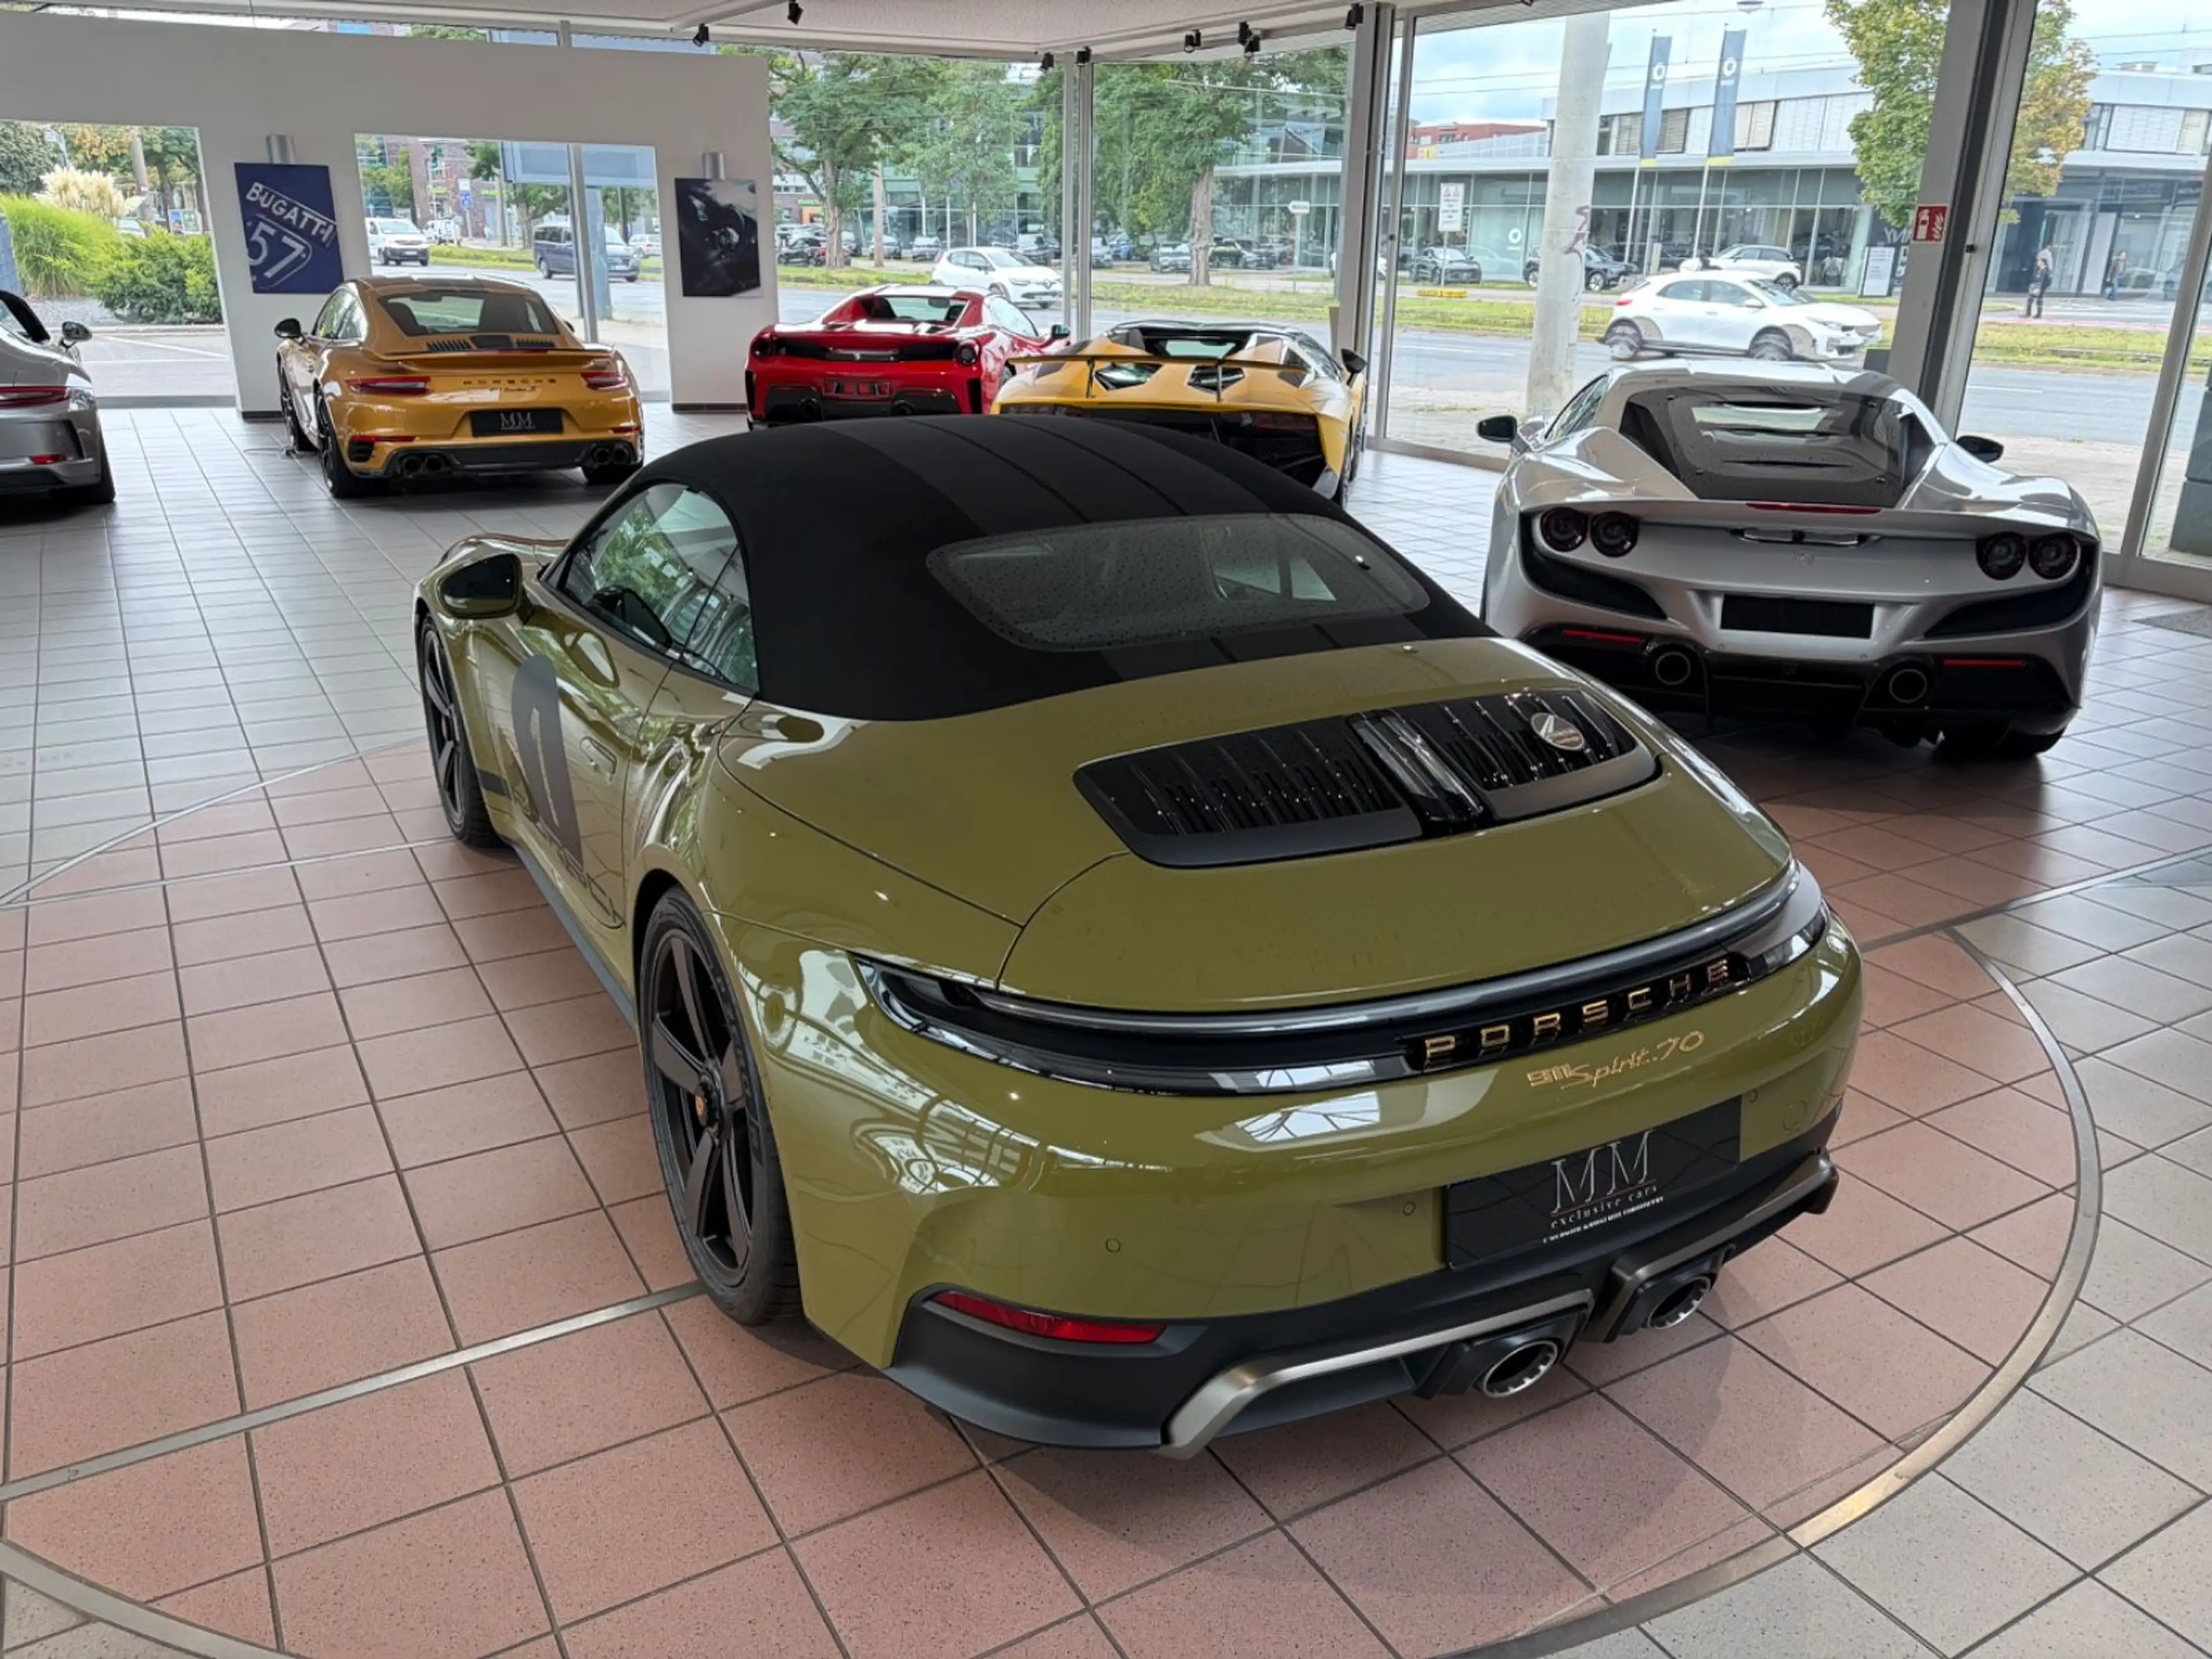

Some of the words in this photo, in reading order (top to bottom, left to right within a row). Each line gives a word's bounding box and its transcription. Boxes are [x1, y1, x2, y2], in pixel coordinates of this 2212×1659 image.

[246, 182, 334, 243] BUGATTI
[248, 221, 306, 279] 57
[1425, 959, 1728, 1058] PORSCHE
[1551, 1130, 1656, 1214] MM
